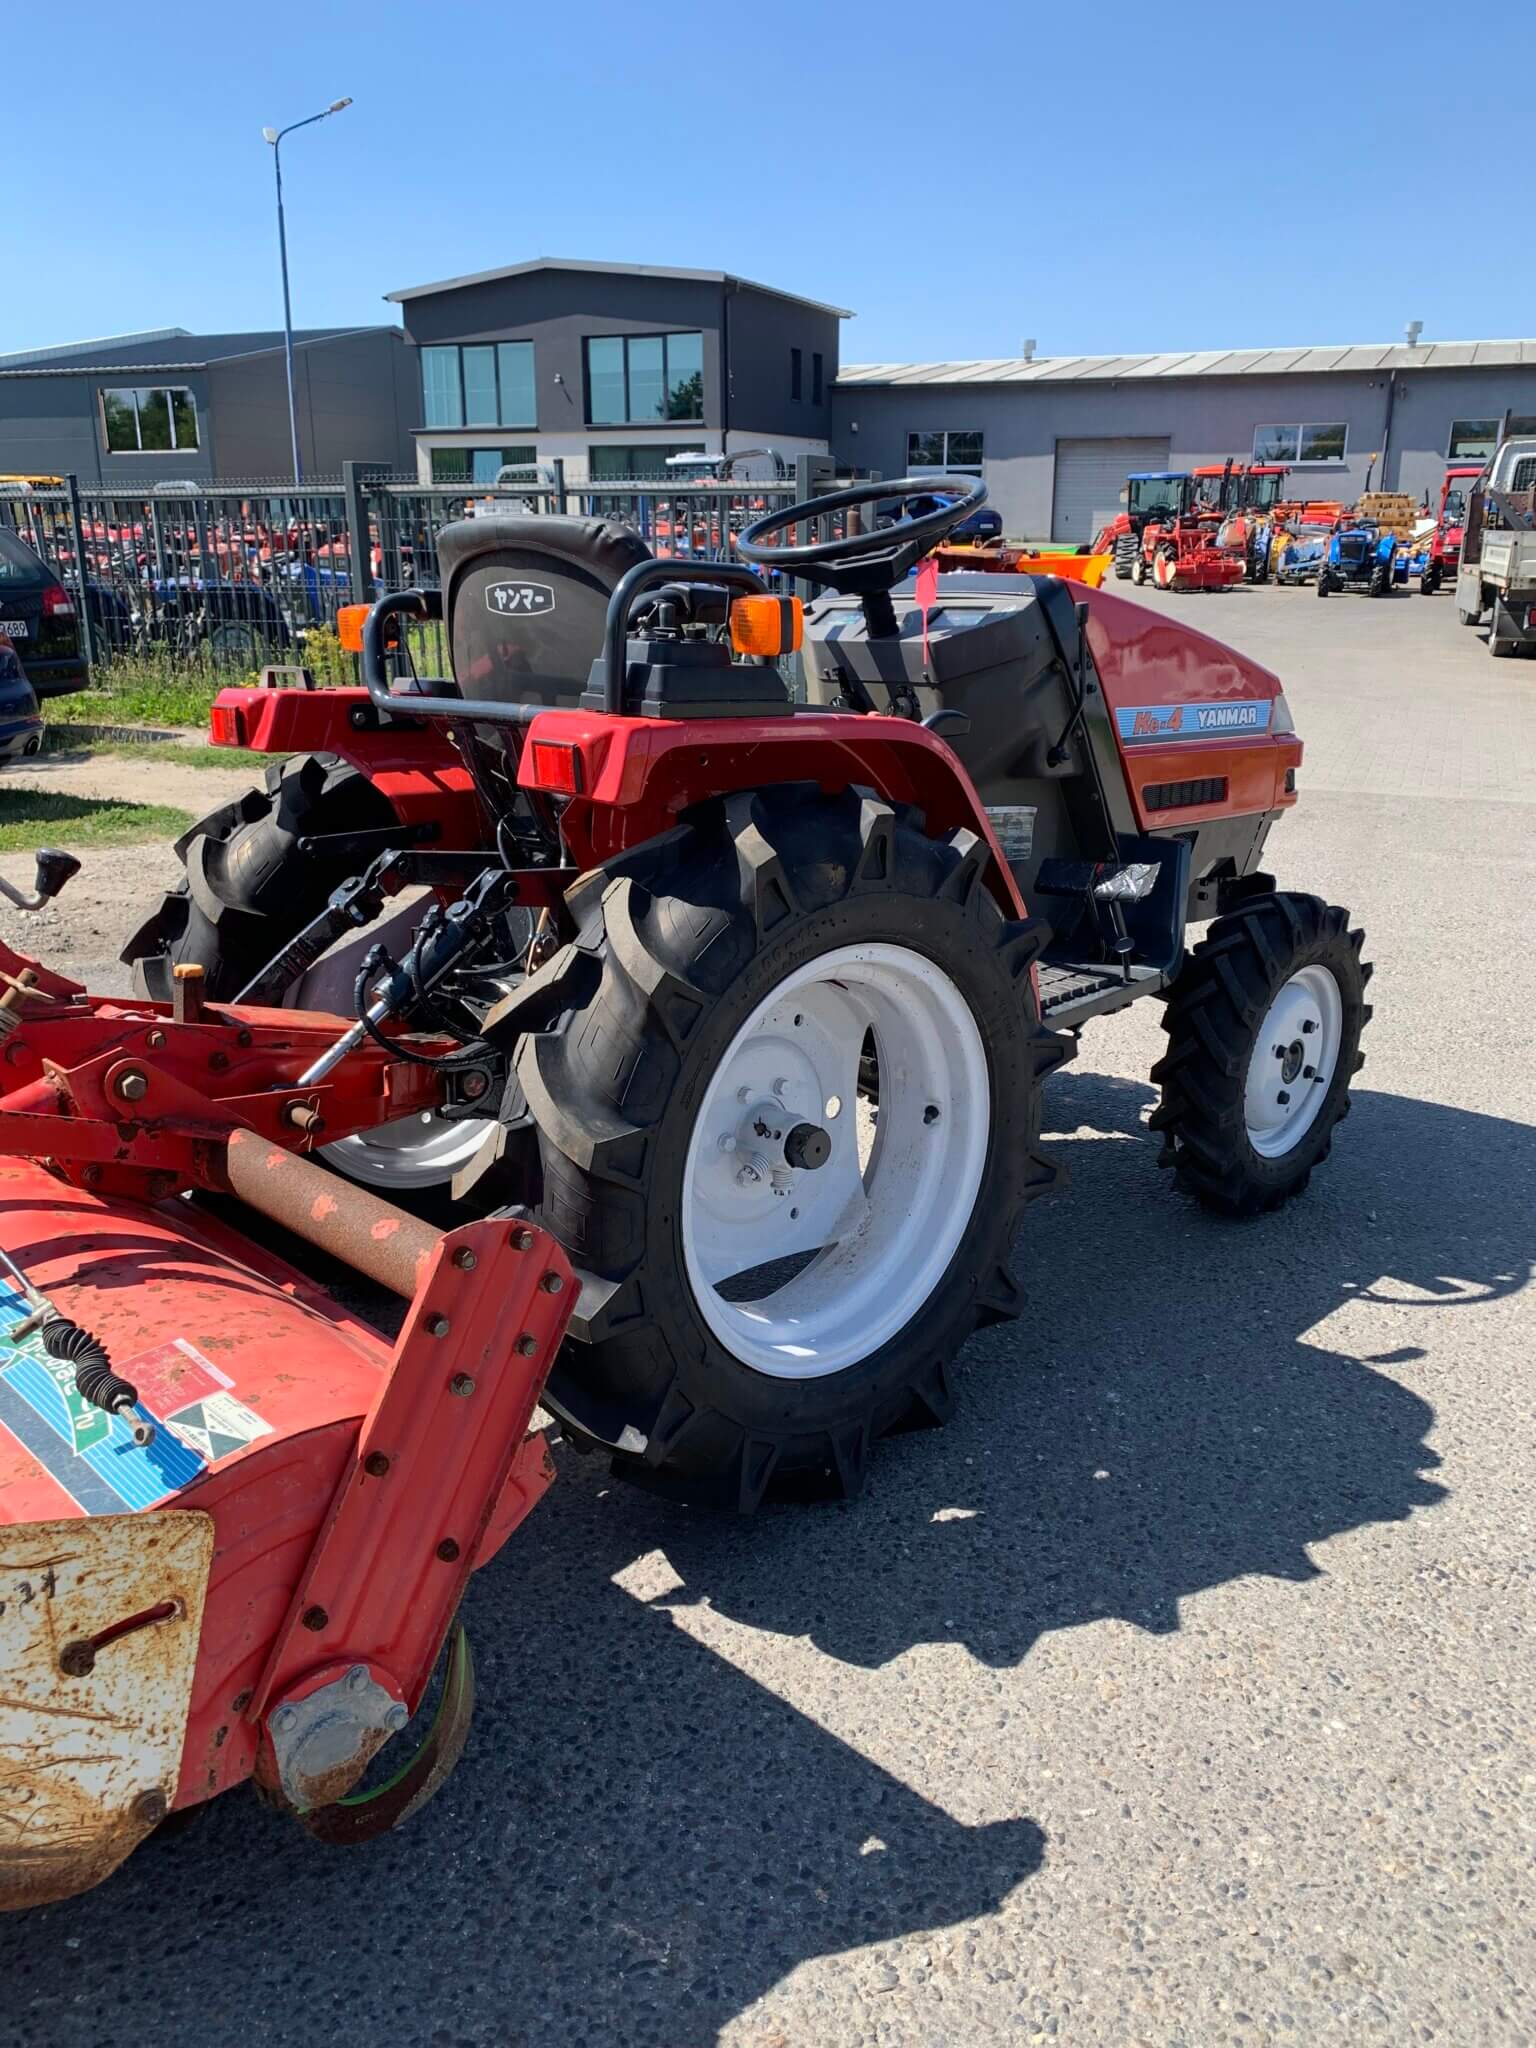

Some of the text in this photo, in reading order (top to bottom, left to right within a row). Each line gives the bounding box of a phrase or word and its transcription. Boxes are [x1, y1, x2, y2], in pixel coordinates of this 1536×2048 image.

[494, 587, 545, 610] ヤンマー
[1198, 706, 1257, 729] YANMAR
